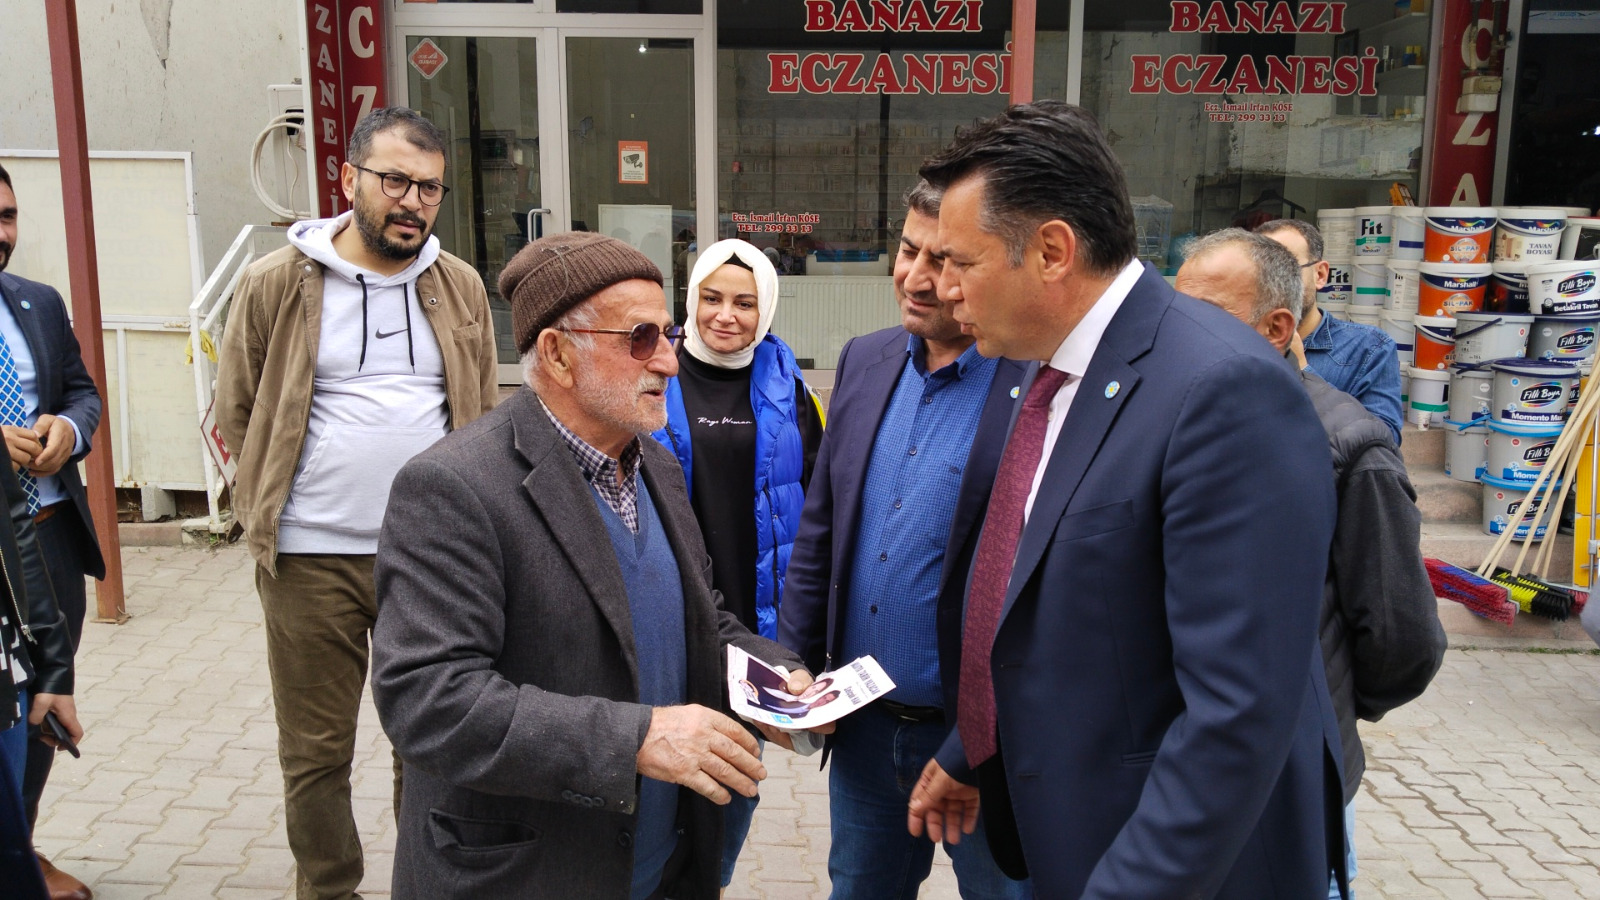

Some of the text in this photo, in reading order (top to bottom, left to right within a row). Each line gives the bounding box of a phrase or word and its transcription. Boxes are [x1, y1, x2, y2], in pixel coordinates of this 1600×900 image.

[804, 0, 983, 32] BANAZI
[1169, 1, 1348, 34] BANAZI
[1129, 46, 1380, 96] ECZANESİ
[1209, 113, 1285, 122] TEL: 299 33 13
[737, 223, 813, 233] TEL: 299 33 13
[1361, 218, 1383, 236] Fit
[1444, 280, 1478, 288] Marshall
[1523, 389, 1540, 400] Filli
[1511, 412, 1550, 421] Momento
